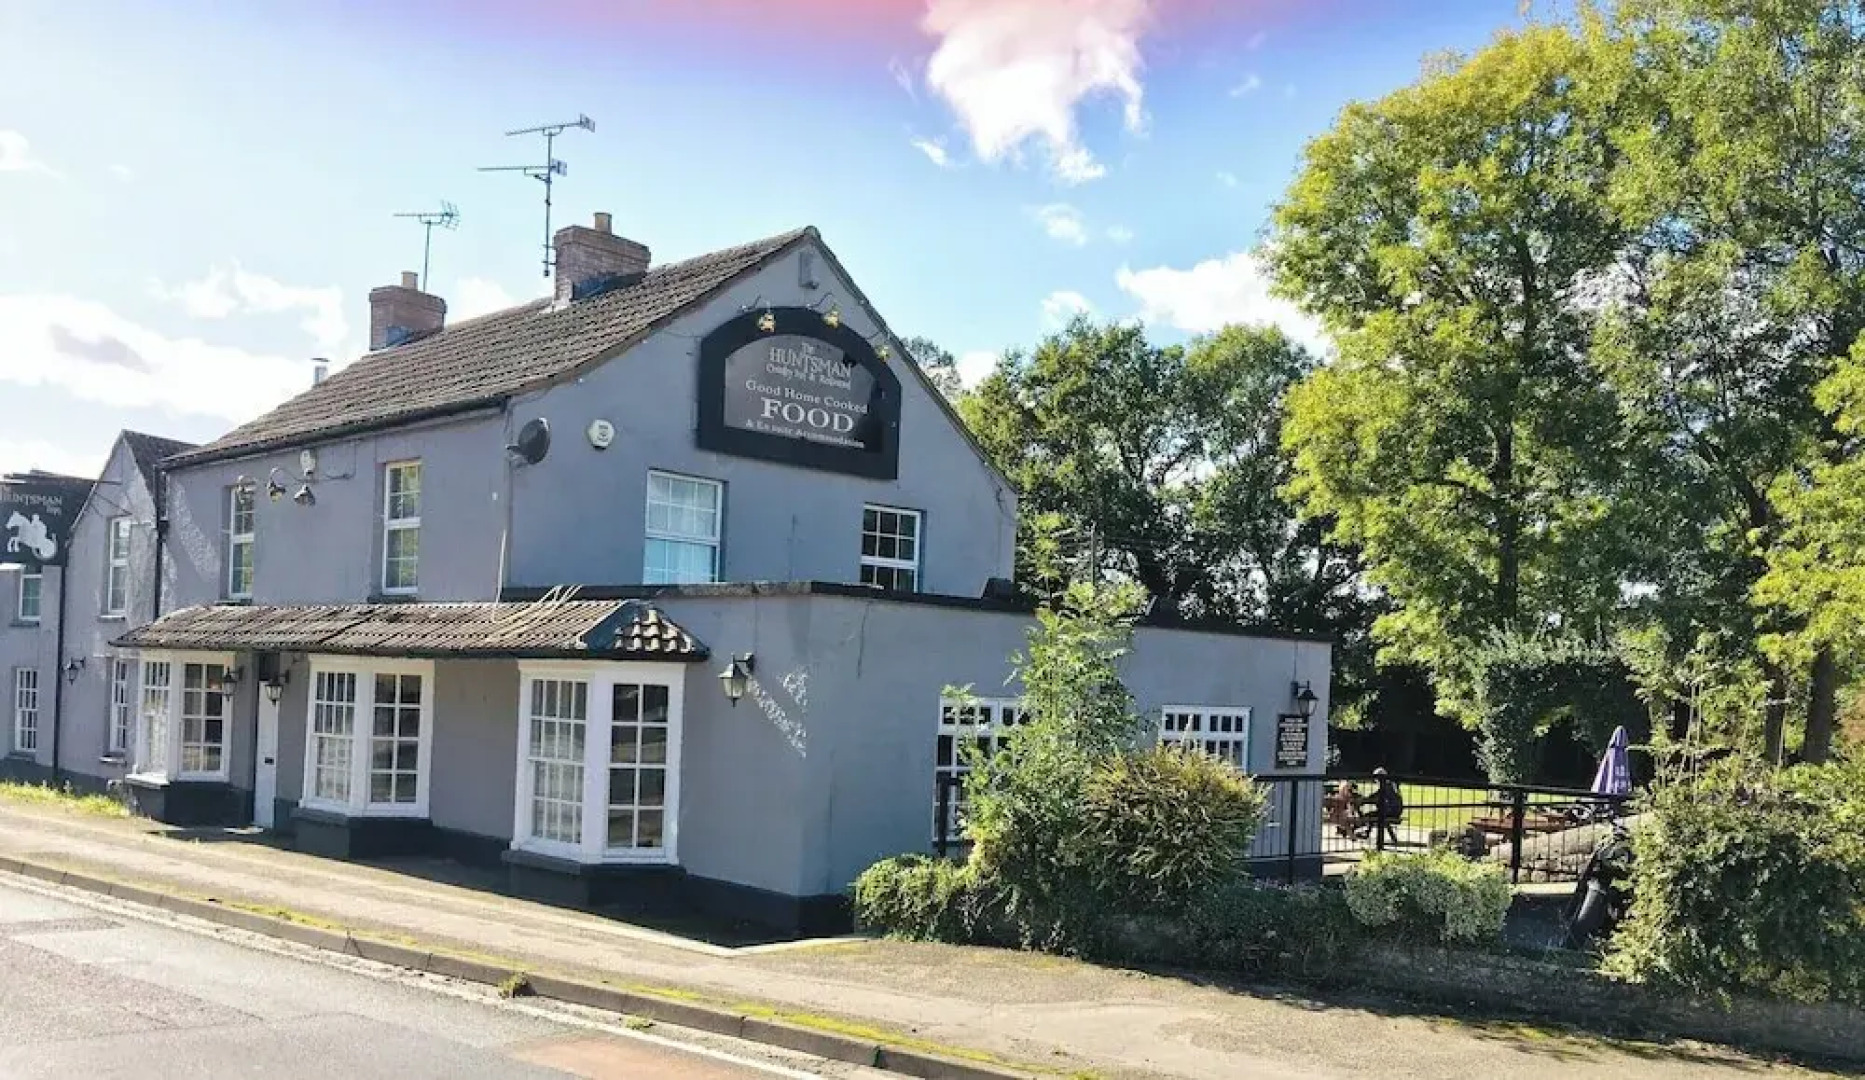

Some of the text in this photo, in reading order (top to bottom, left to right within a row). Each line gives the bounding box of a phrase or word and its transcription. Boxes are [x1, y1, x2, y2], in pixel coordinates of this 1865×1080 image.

[769, 347, 850, 377] HUNTSMAN
[746, 379, 868, 413] Good Home Cooked
[745, 419, 754, 428] &
[760, 397, 854, 432] FOOD
